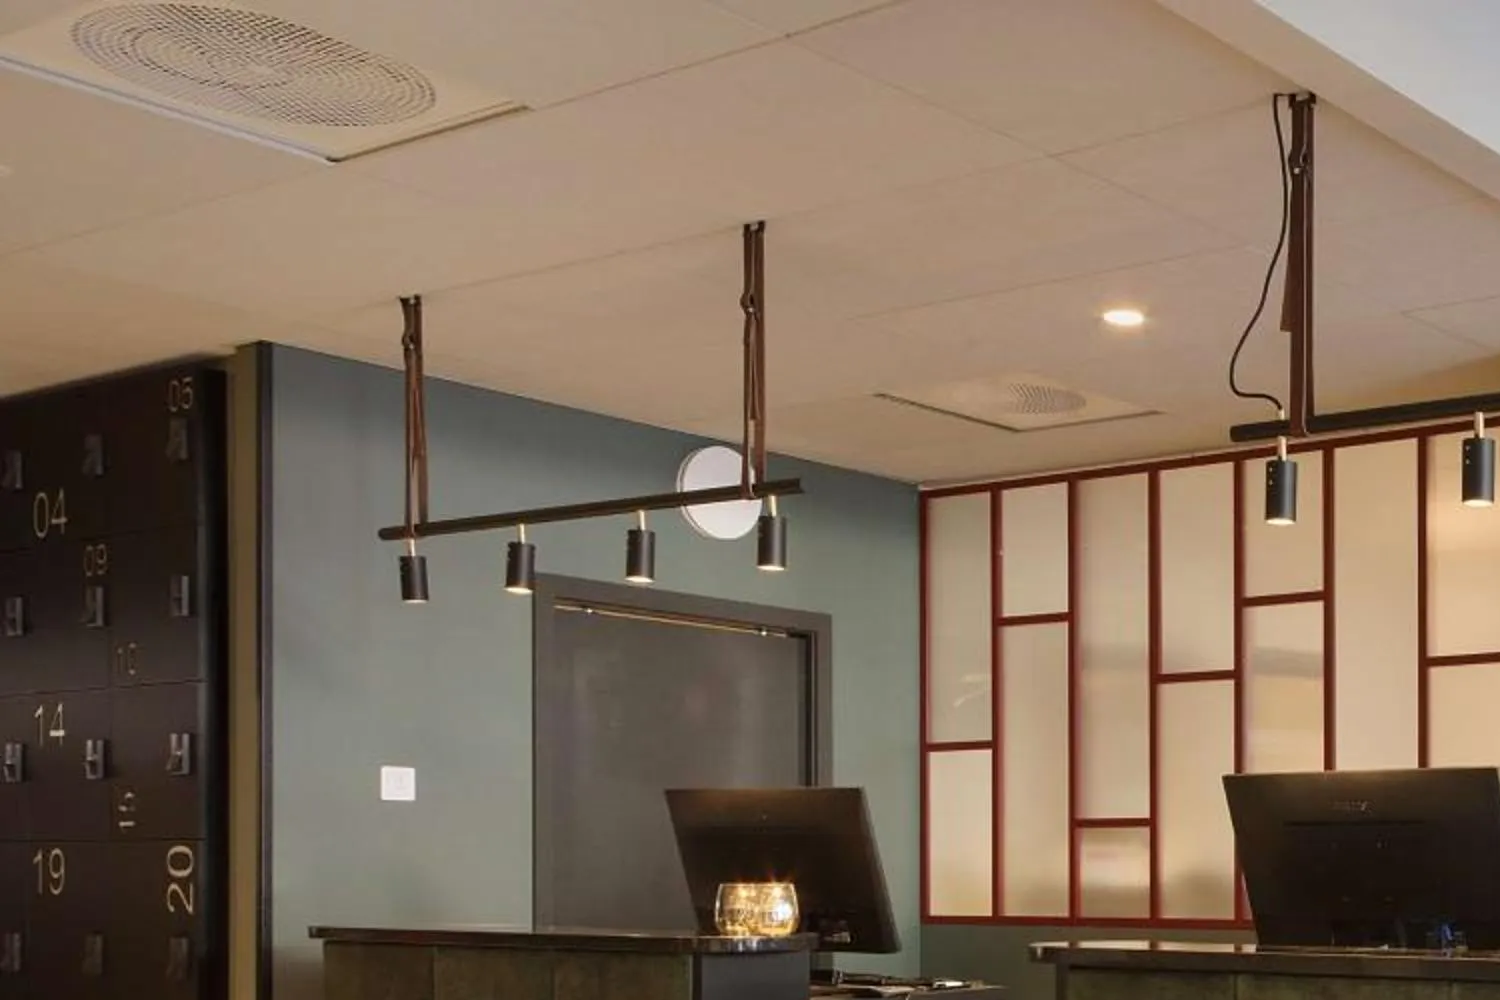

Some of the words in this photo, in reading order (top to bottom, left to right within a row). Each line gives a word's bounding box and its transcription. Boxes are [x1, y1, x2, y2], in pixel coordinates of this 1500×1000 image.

[166, 376, 194, 412] 05
[33, 488, 68, 539] 04
[83, 544, 108, 577] 09
[34, 703, 65, 746] 14
[33, 848, 65, 895] 19
[167, 845, 195, 915] 20
